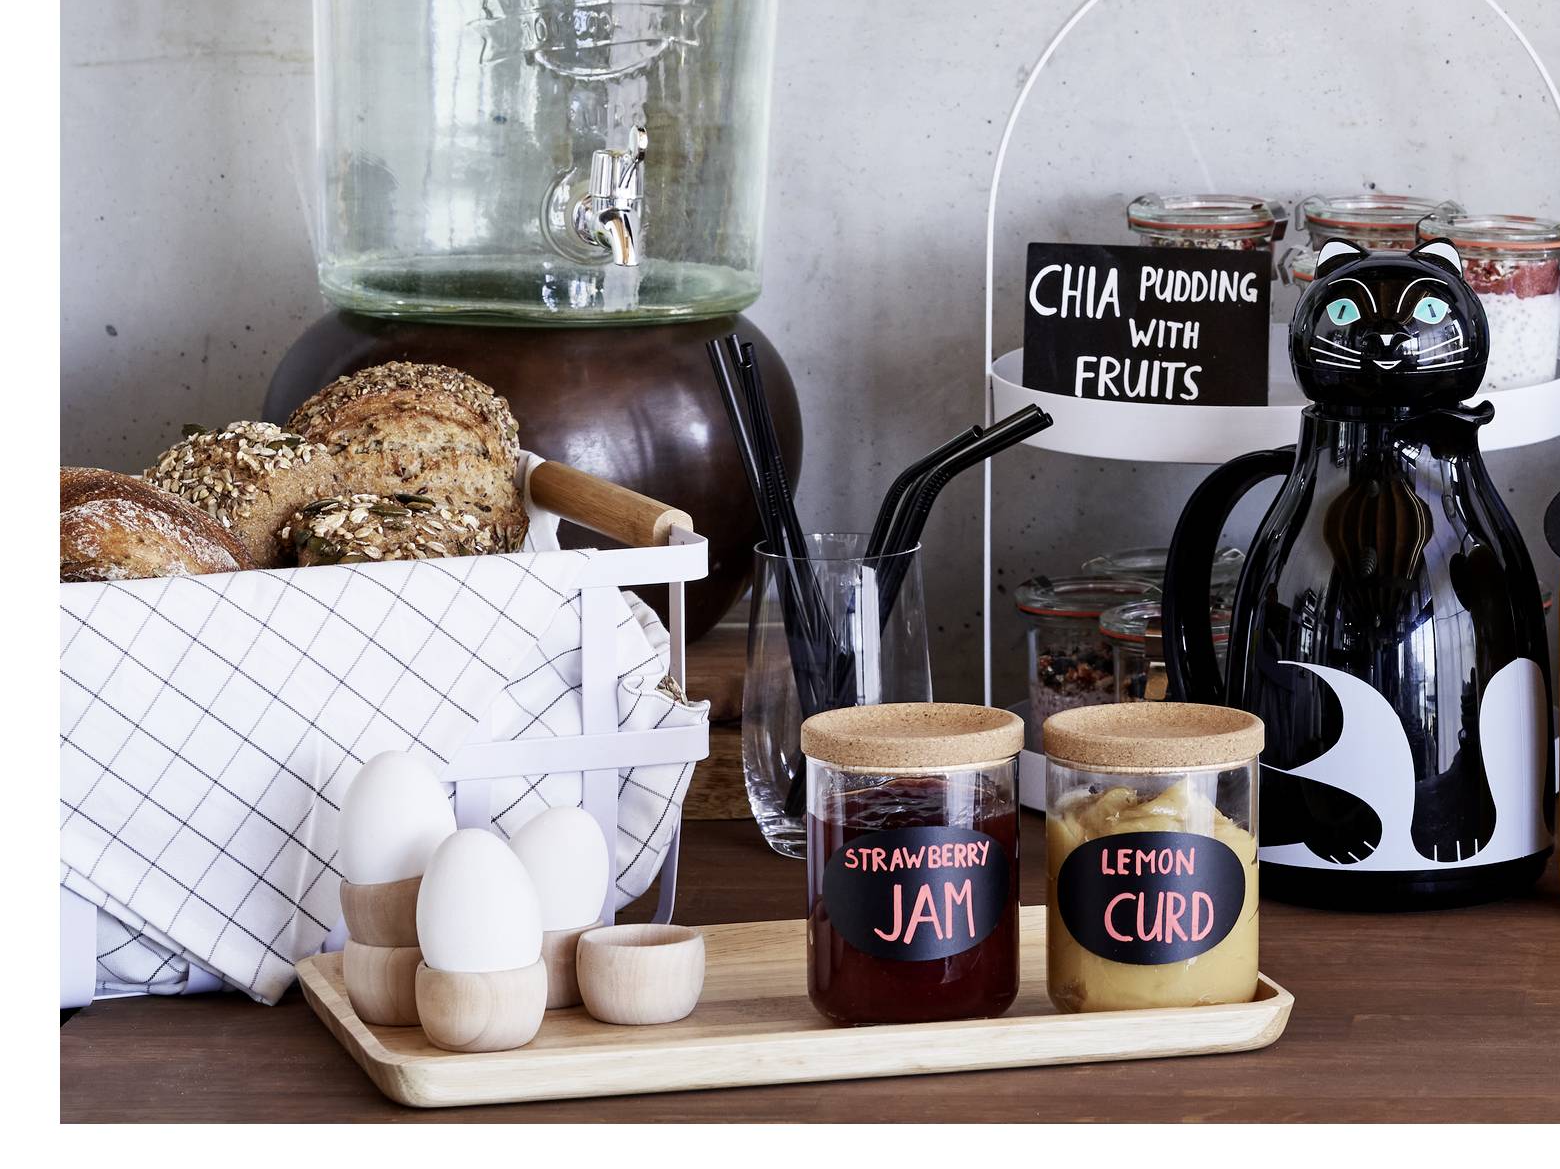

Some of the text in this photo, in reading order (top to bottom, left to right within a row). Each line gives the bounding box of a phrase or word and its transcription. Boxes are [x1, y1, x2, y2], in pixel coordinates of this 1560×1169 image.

[1029, 263, 1258, 320] CHIA PUDDING
[1128, 317, 1200, 350] WITH
[1074, 355, 1204, 402] FRUITS
[843, 839, 991, 873] STRAWBERRY
[1101, 846, 1196, 877] LEMON
[873, 879, 976, 945] JAM
[1103, 890, 1216, 943] CURD
